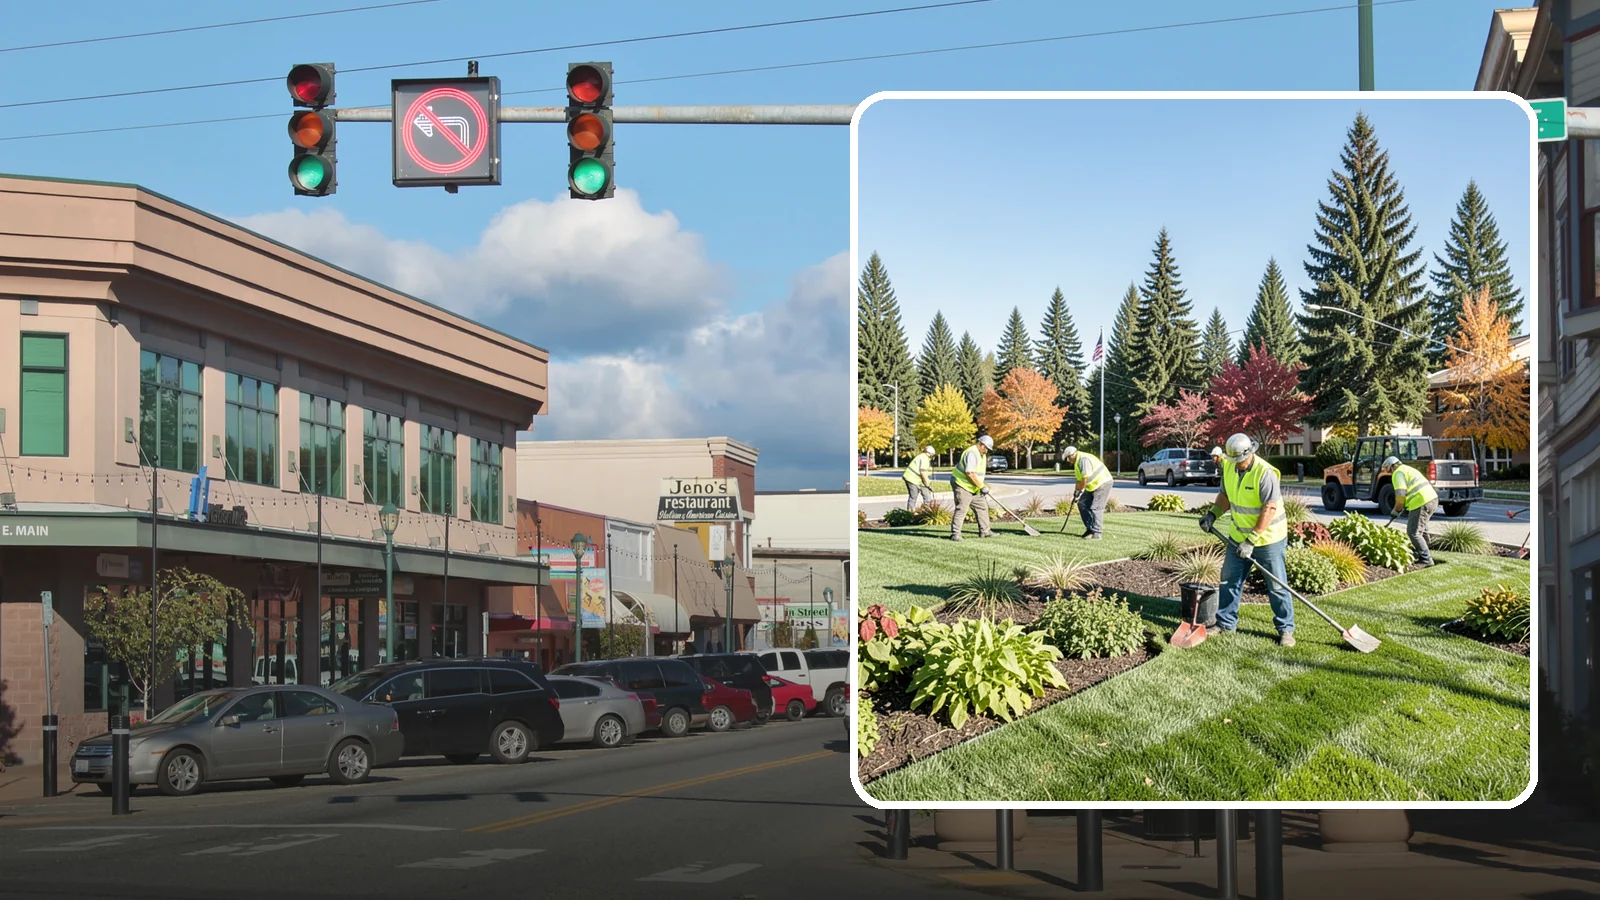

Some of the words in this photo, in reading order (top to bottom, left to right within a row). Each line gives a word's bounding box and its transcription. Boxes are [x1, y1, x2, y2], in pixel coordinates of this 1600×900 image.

[669, 480, 728, 495] Jeno's
[665, 496, 731, 509] restaurant
[658, 510, 682, 519] Italian
[686, 509, 714, 519] American
[715, 509, 738, 519] Cuisine
[2, 525, 13, 536] E.
[15, 525, 49, 536] MAIN
[797, 607, 829, 617] Street
